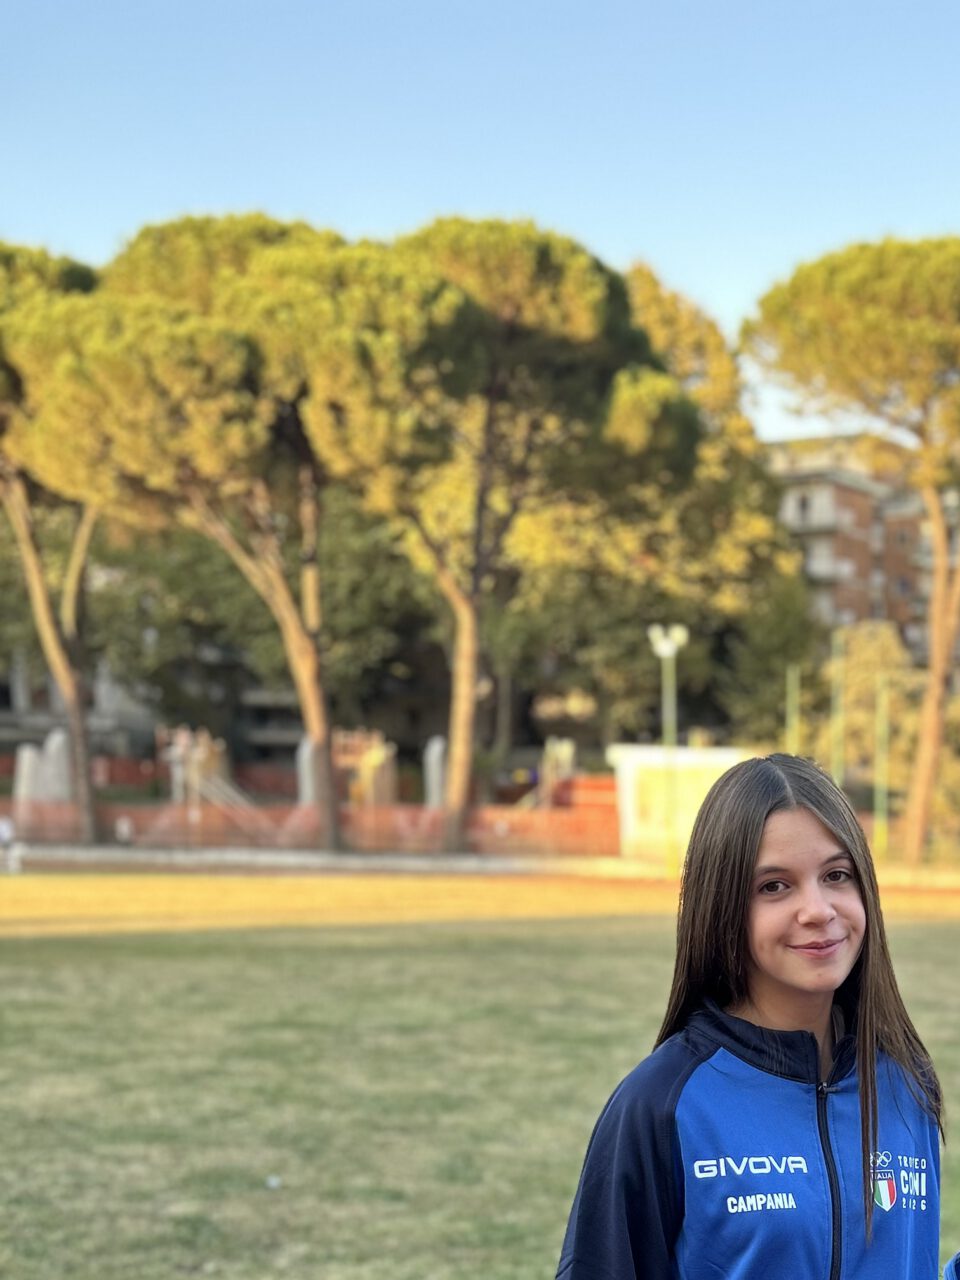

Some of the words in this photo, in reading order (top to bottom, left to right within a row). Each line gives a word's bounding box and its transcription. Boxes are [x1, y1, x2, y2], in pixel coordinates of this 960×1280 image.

[694, 1155, 808, 1178] GIVOVA
[897, 1155, 927, 1169] TROEO
[726, 1193, 797, 1213] CAMPANIA
